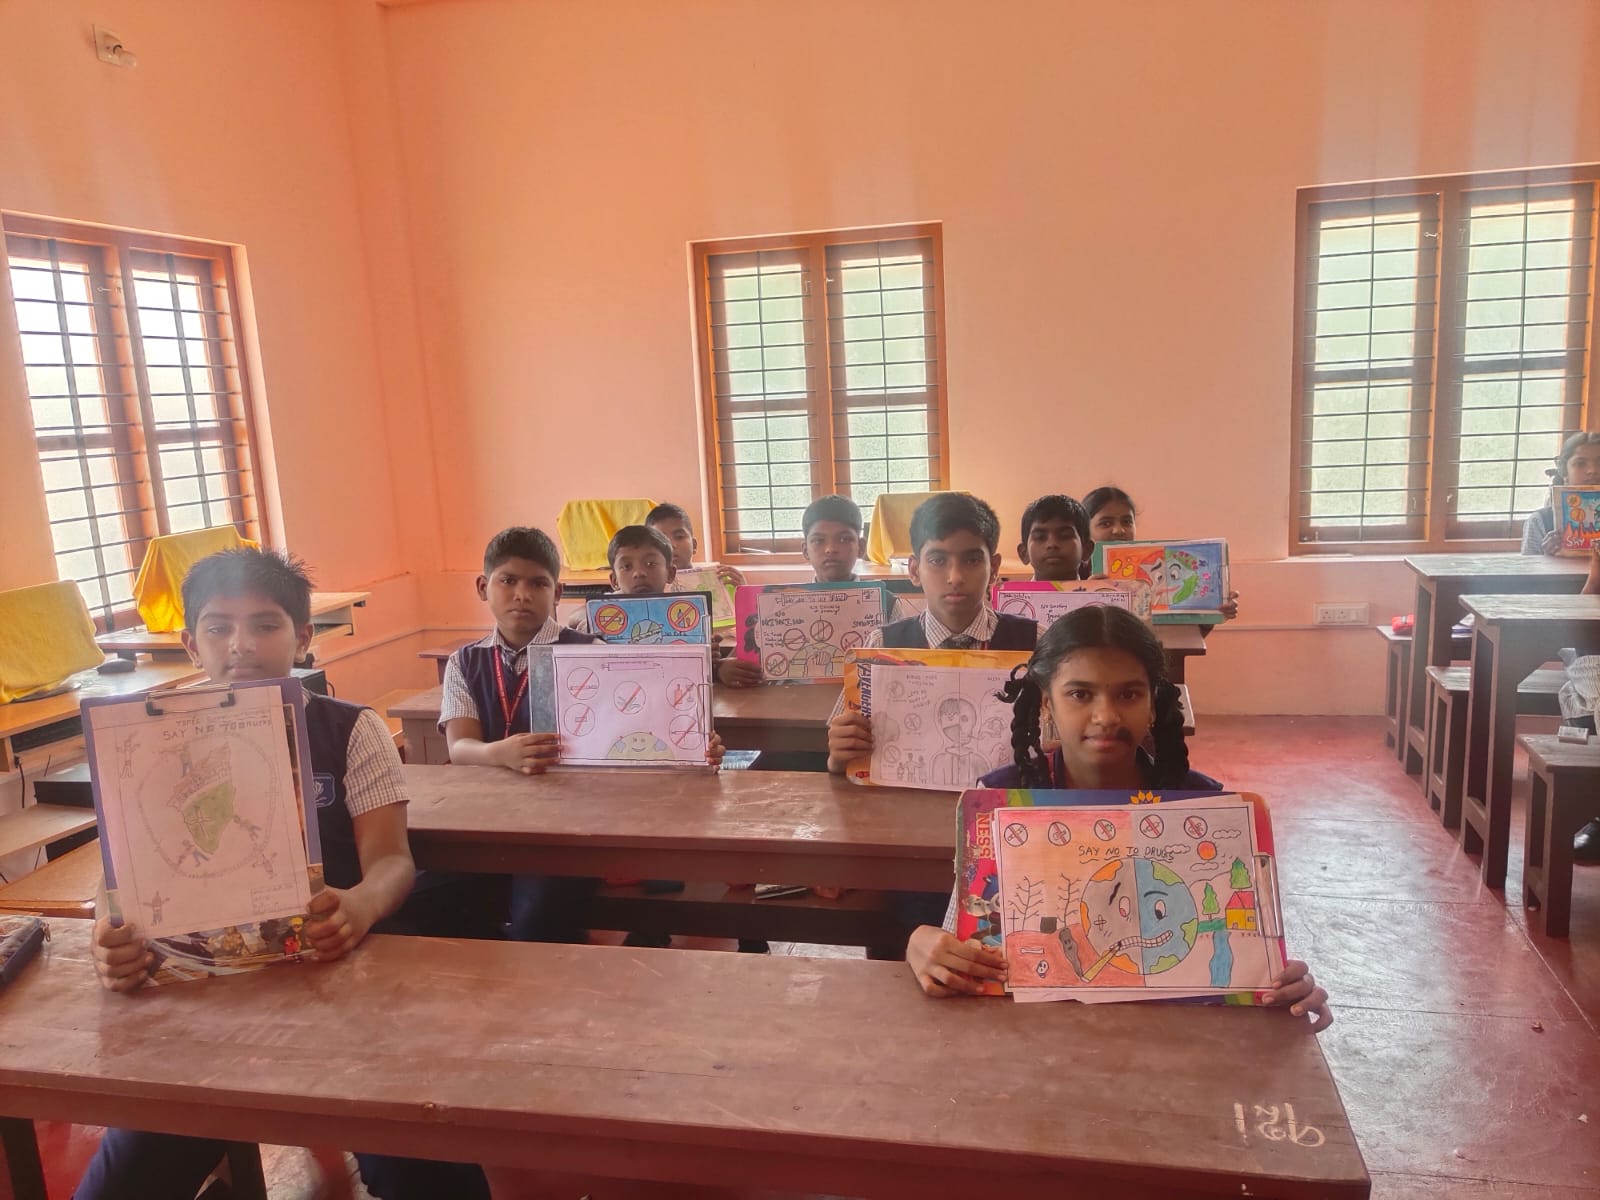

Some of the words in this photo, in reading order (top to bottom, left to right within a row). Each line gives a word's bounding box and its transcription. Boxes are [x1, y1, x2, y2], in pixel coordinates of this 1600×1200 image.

[163, 729, 186, 741] SAY
[1078, 844, 1100, 857] SAY
[1105, 846, 1120, 856] NO
[1125, 846, 1139, 855] TO
[1143, 846, 1175, 861] DRUGS
